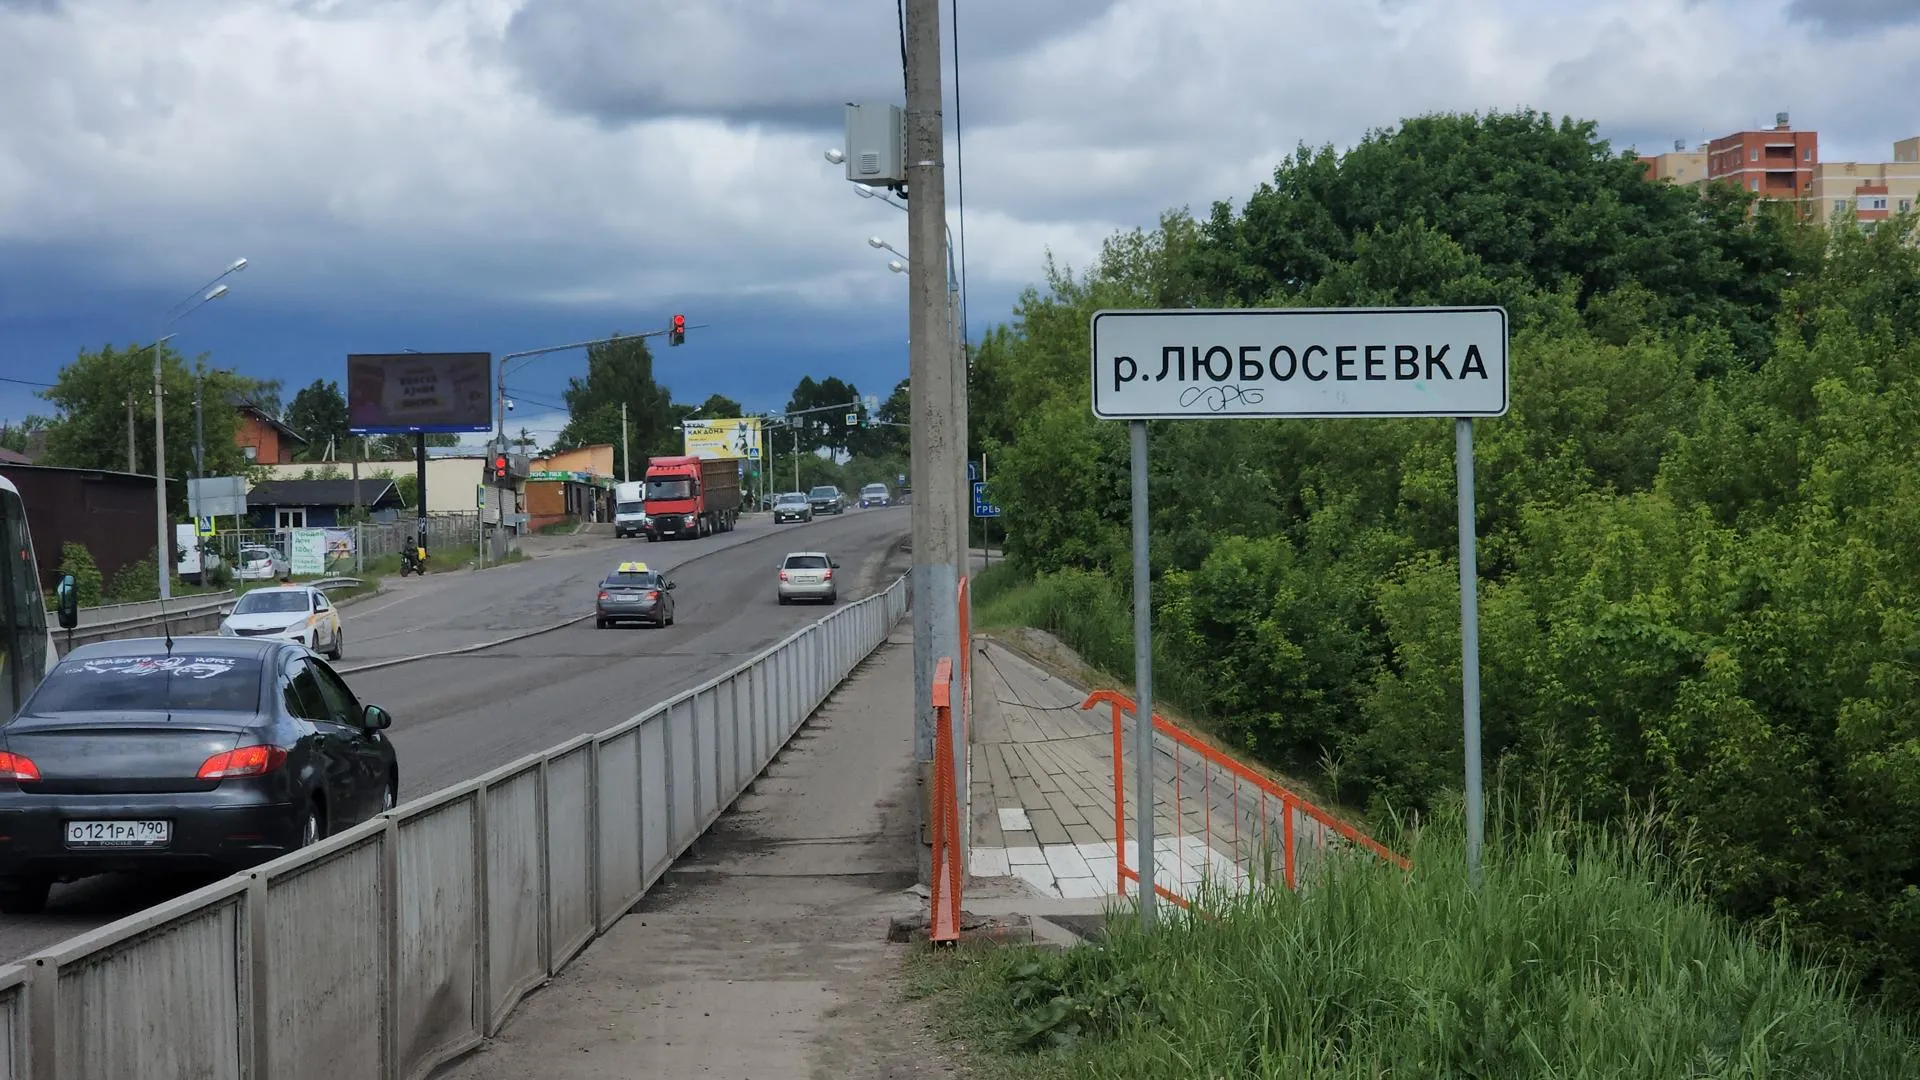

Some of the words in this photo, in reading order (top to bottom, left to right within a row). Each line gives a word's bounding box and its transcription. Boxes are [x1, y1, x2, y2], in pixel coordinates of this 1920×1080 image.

[1113, 344, 1489, 392] р.ЛЮБОСЕЕВКА
[194, 657, 236, 665] MORI
[138, 822, 163, 835] 790
